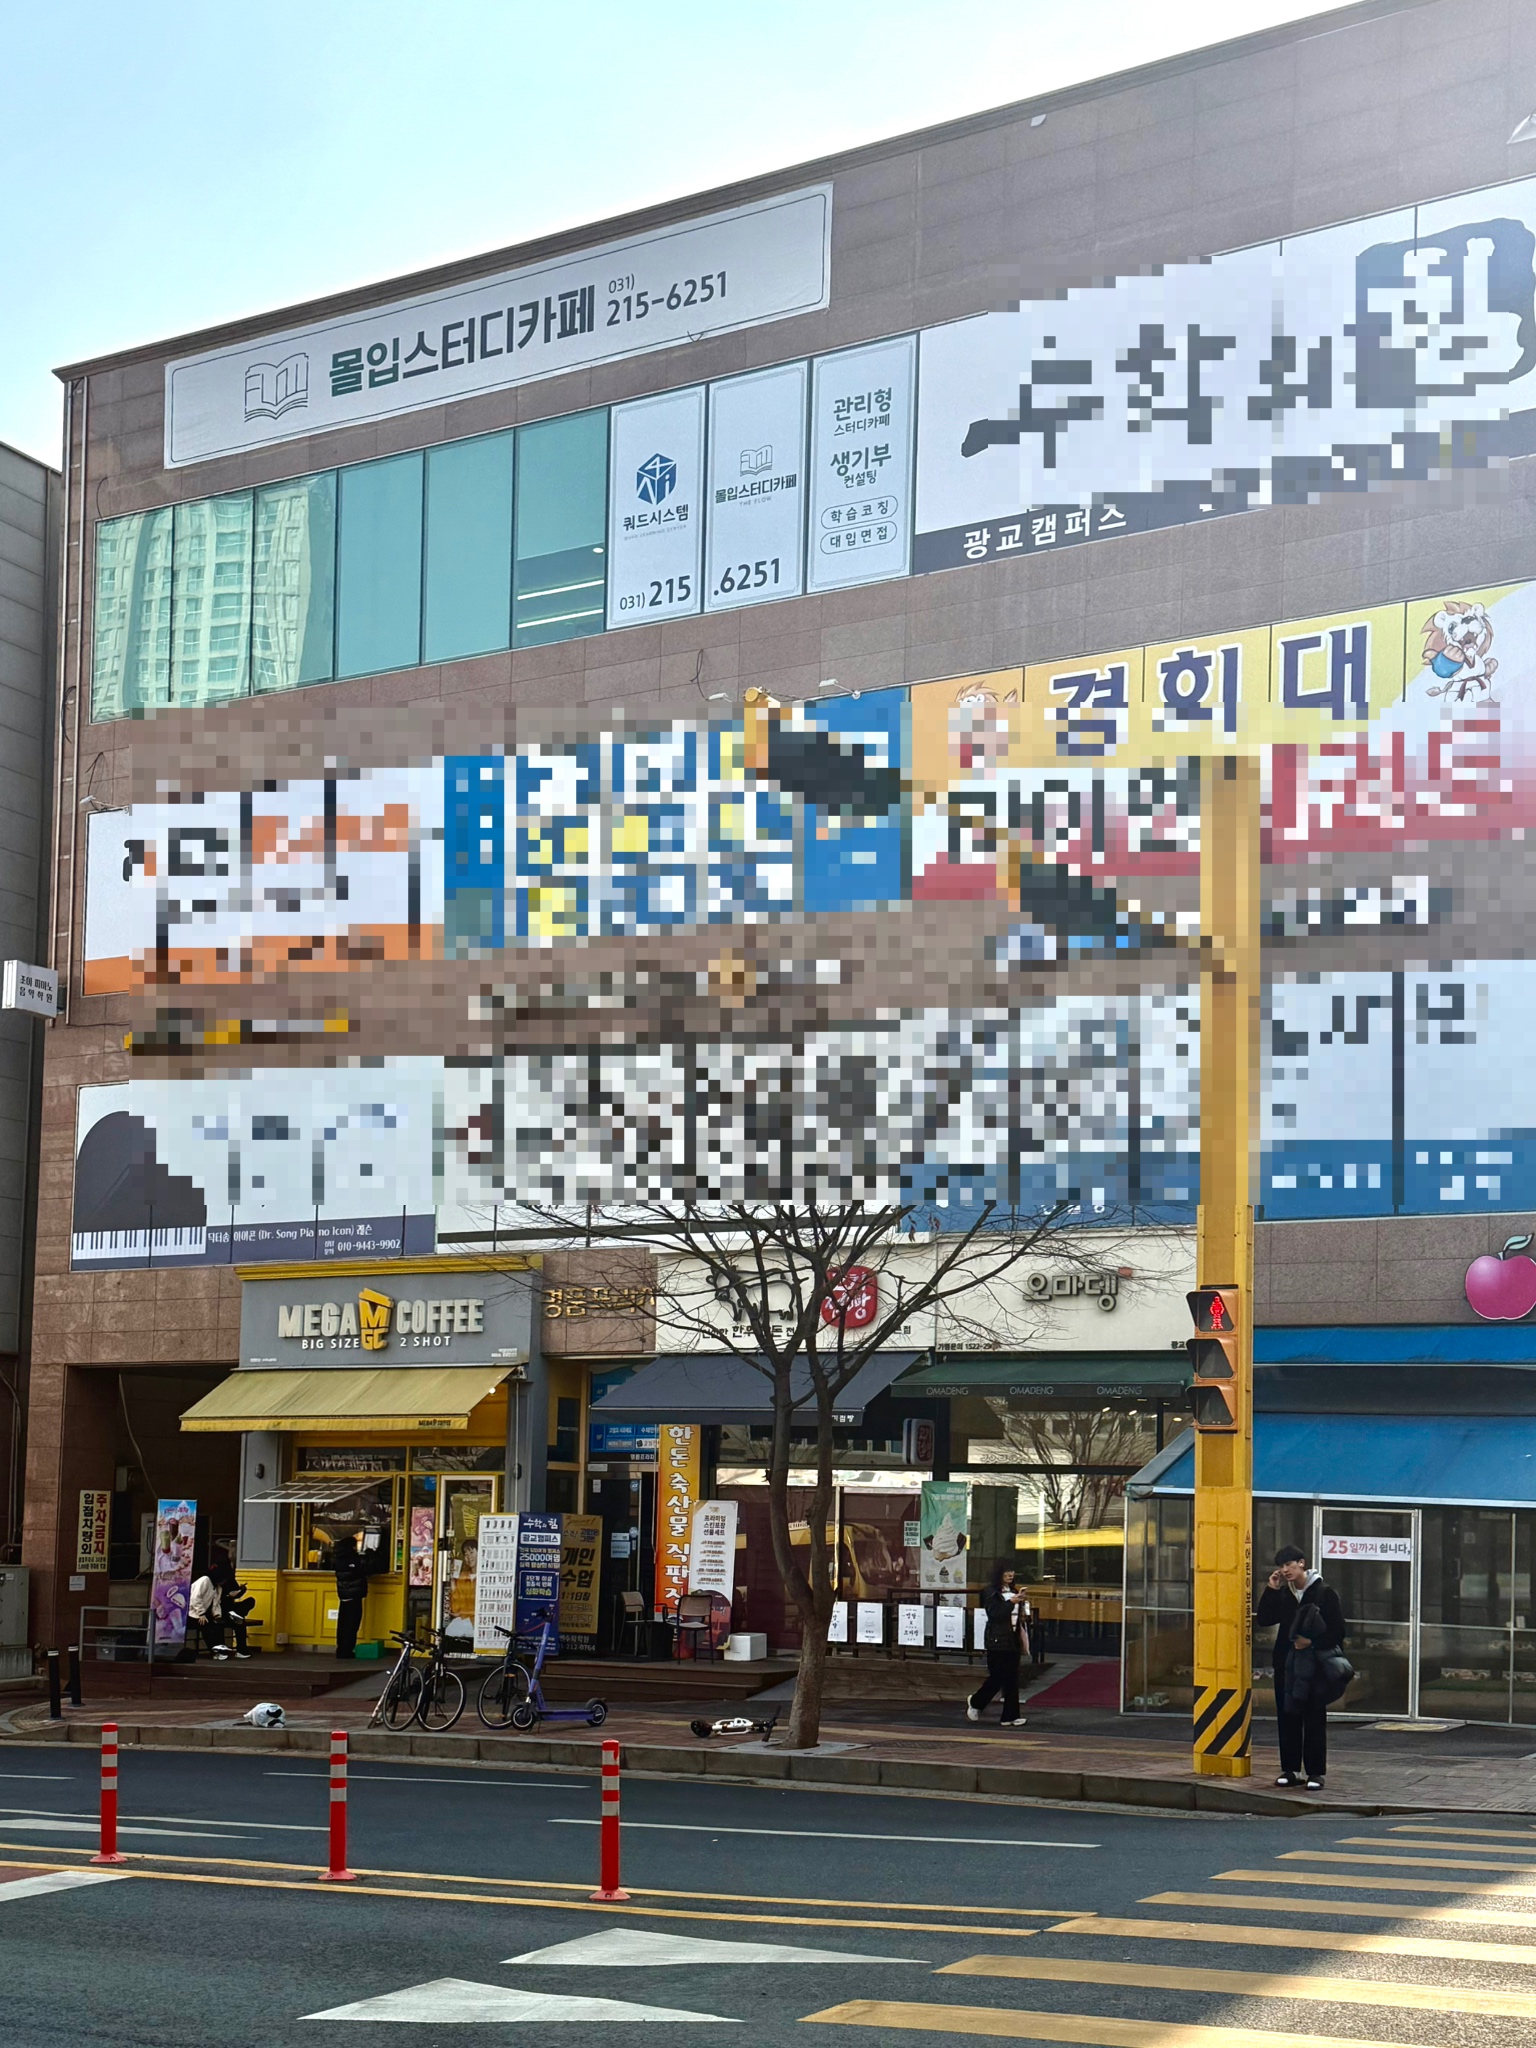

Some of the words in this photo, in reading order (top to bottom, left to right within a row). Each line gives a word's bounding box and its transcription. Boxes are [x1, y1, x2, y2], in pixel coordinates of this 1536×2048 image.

[608, 273, 636, 294] 031)
[606, 270, 728, 327] 215-6251
[329, 285, 596, 397] 몰입스터디카페
[833, 387, 892, 422] 관리형
[833, 413, 890, 437] 스터디카페
[830, 443, 892, 477] 생기부
[715, 473, 797, 504] 몰입스터디카페
[843, 469, 878, 489] 컨설팅
[623, 504, 689, 531] 쿼드시스템
[830, 499, 889, 523] 학습코칭
[829, 525, 888, 549] 대입면접
[962, 507, 1127, 560] 광교캠퍼스
[619, 592, 646, 611] 031)
[648, 575, 692, 607] 215
[20, 975, 33, 987] 조이
[34, 978, 53, 992] 피아노
[258, 1230, 275, 1241] (Dr.
[276, 1229, 297, 1240] Song
[332, 1224, 354, 1236] Icon)
[337, 1238, 401, 1251] 010-9443-9902
[1022, 1272, 1118, 1314] 오마뎅
[278, 1303, 357, 1338] MEGA
[396, 1299, 485, 1334] COFFEE
[302, 1339, 324, 1349] BIG
[330, 1337, 360, 1349] SIZE
[400, 1336, 407, 1347] 2
[413, 1335, 451, 1347] SHOT
[926, 1386, 968, 1395] OMADENG
[1009, 1386, 1053, 1395] OMADENG
[1097, 1386, 1142, 1395] OMADENG
[668, 1426, 694, 1468] 한돈
[666, 1472, 692, 1537] 축산물
[94, 1493, 107, 1556] 주차금지
[548, 1518, 559, 1530] 힘
[562, 1547, 595, 1567] 개인
[560, 1568, 594, 1589] 수업
